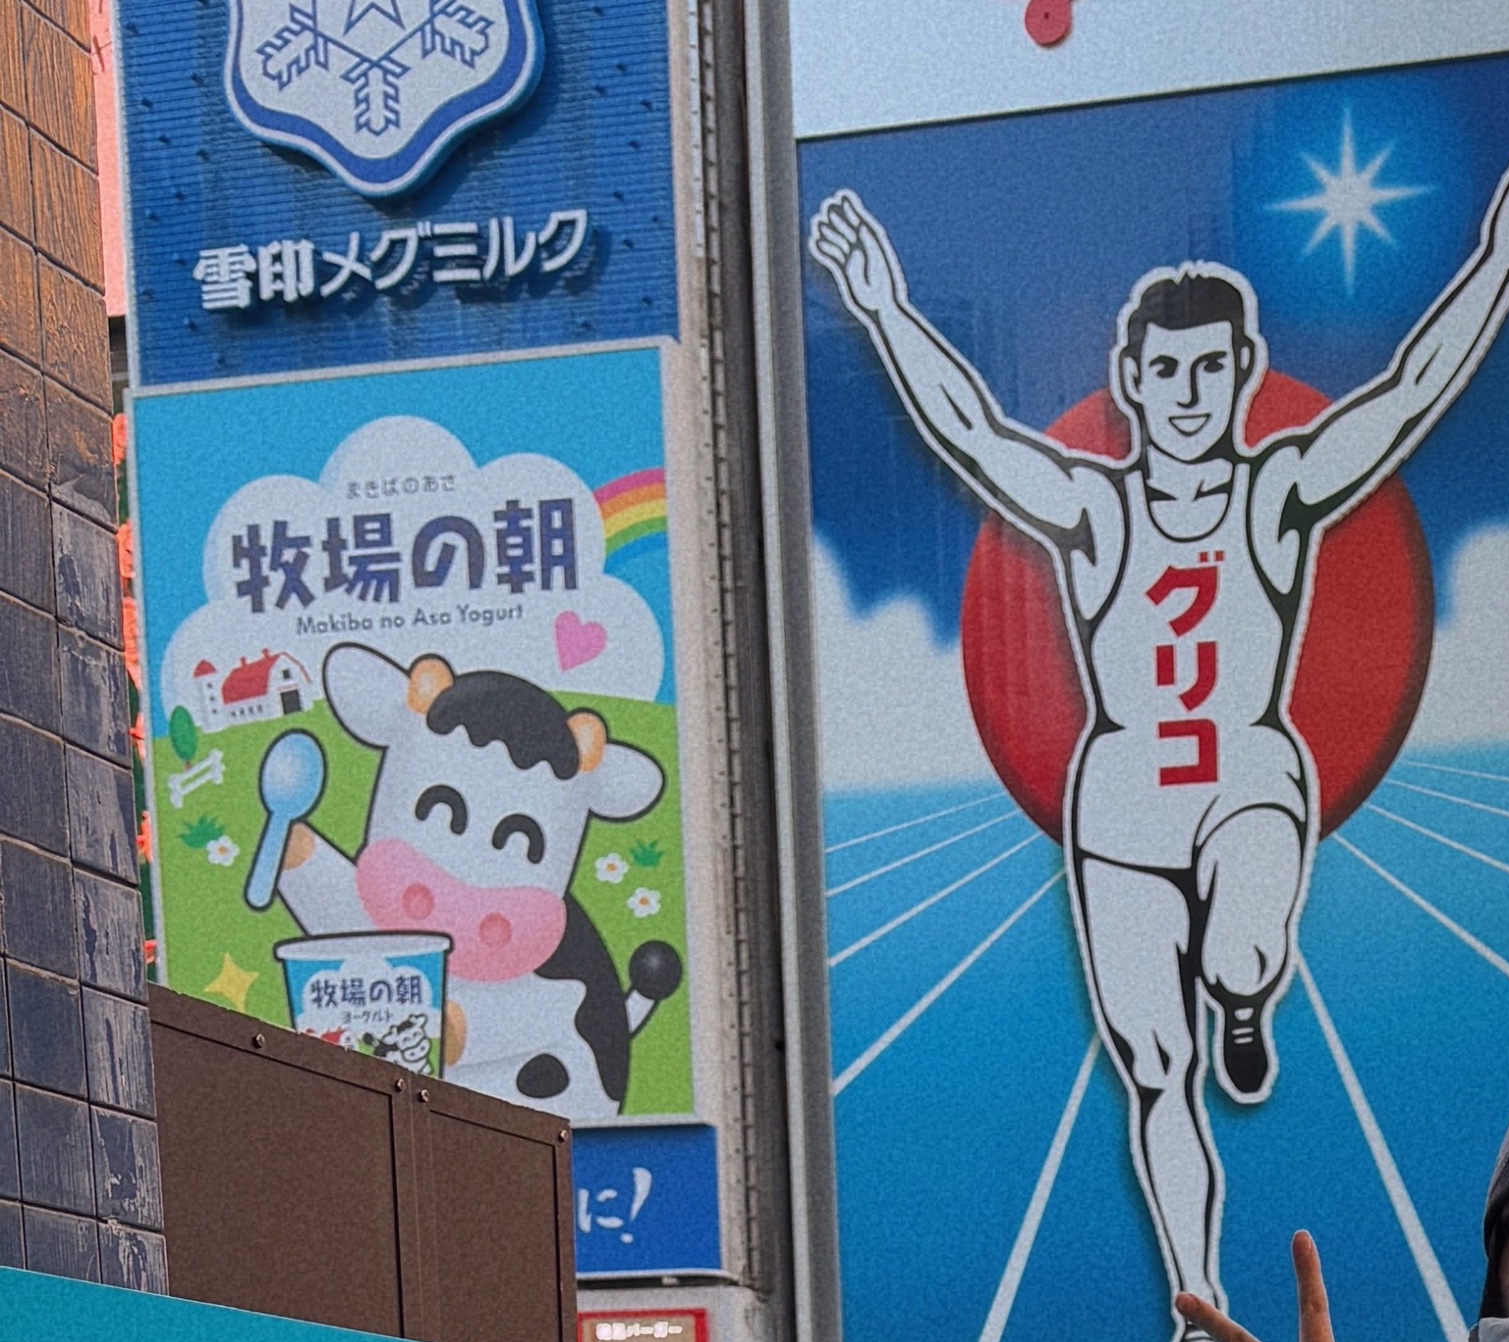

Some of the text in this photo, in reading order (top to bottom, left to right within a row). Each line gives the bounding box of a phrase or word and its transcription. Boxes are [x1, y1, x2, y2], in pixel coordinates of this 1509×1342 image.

[192, 208, 588, 311] 雪印メグミルク
[231, 498, 578, 613] 牧場の朝
[296, 603, 523, 635] Makiba no Asa Yogurt
[1145, 550, 1225, 787] グリコ
[310, 975, 423, 1009] 牧場の朝
